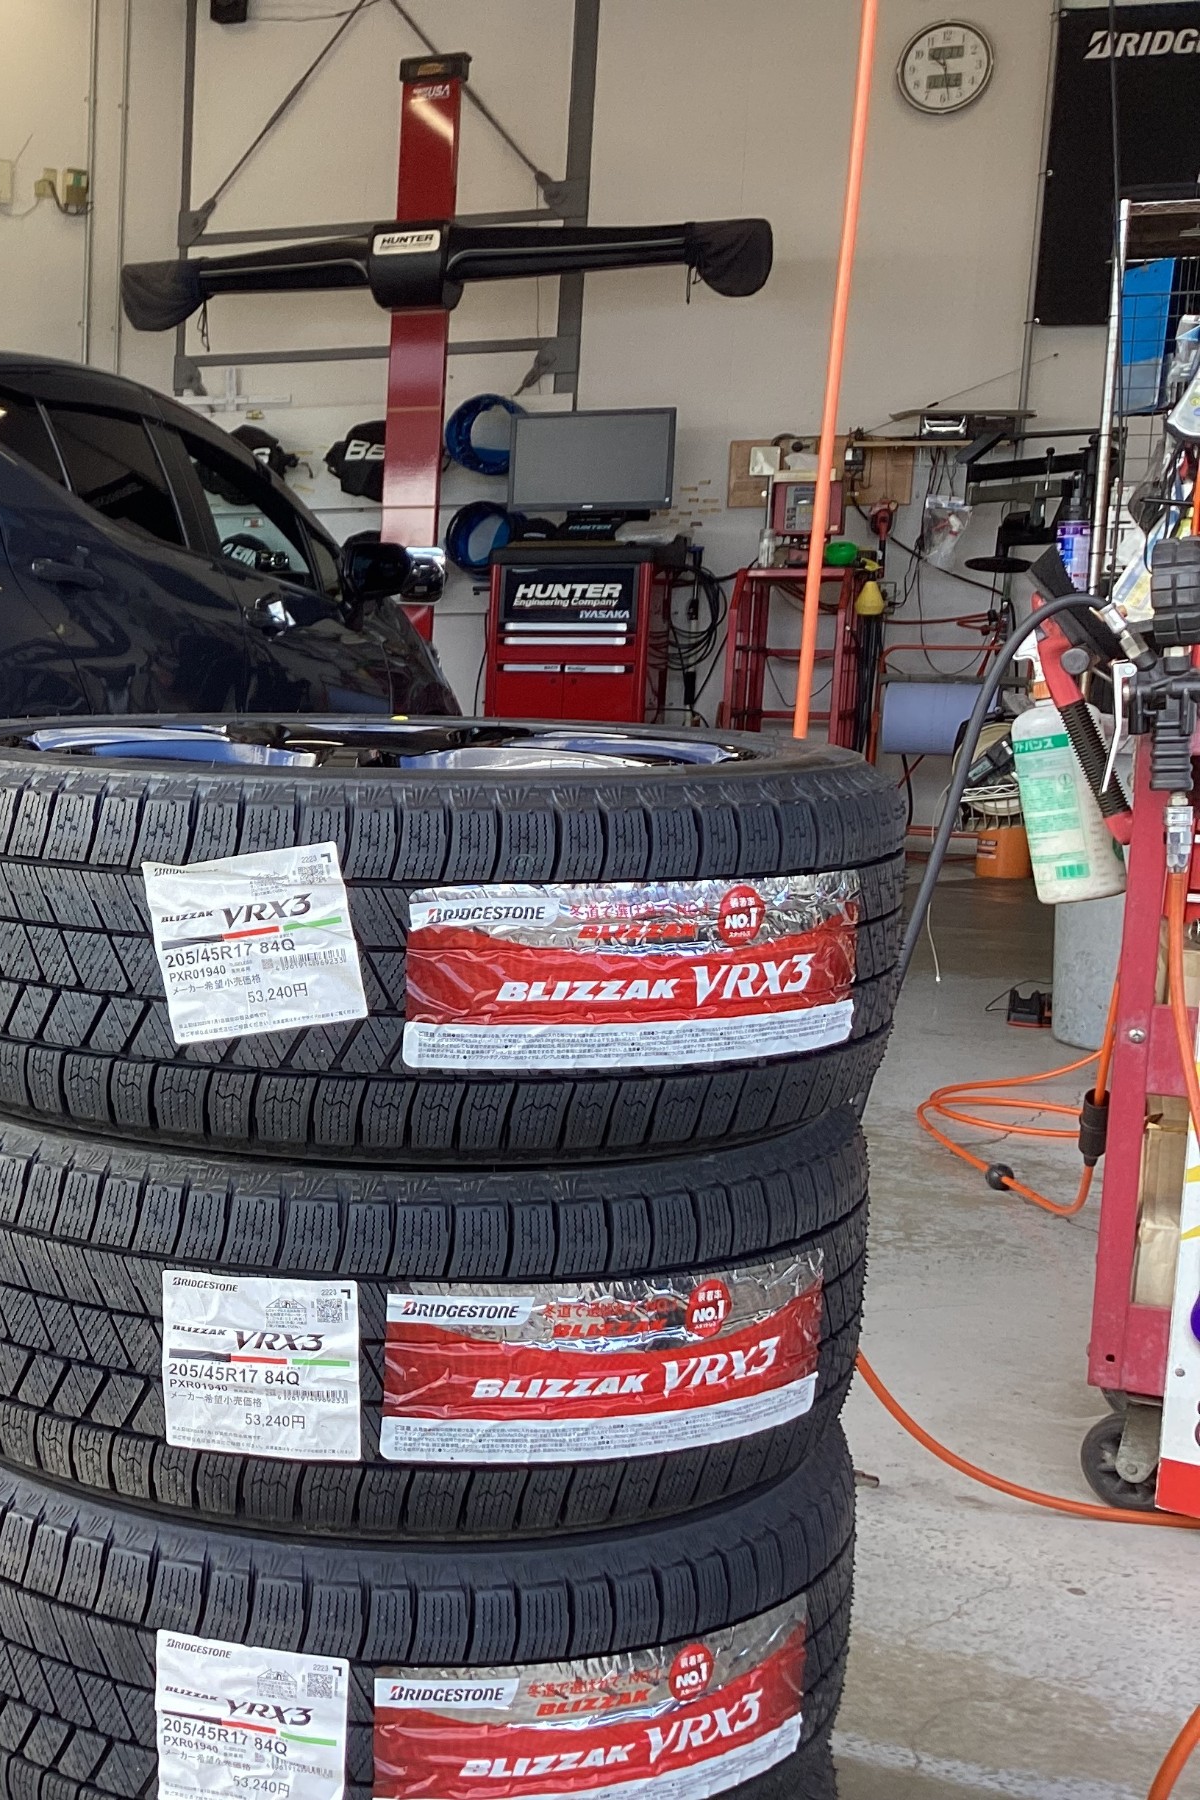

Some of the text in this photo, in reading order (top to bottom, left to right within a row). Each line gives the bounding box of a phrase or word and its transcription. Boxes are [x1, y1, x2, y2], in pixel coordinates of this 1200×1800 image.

[1083, 28, 1200, 59] BRIDG
[382, 234, 434, 244] HUNTER
[516, 584, 622, 598] HUNTER
[513, 598, 618, 608] Engineering Company
[580, 610, 630, 618] IYASAKA
[161, 893, 312, 929] BLIZZAK VRX3
[426, 906, 546, 923] BRIDGESTONE
[725, 908, 759, 929] NO.1
[165, 943, 252, 968] 205/45R17
[260, 939, 295, 954] 84Q
[169, 965, 226, 982] PXR01940
[495, 953, 816, 1007] BLIZZAK VRX3
[173, 974, 261, 995] メーカー希望小売価格
[248, 982, 308, 1003] 53,240円
[172, 1277, 238, 1292] BRIDGESTONE
[402, 1302, 520, 1318] BRIDGESTONE
[692, 1300, 726, 1323] NO.1
[172, 1325, 325, 1351] BLIZZAK VRX3
[170, 1363, 300, 1386] 205/45R17 84Q
[471, 1336, 782, 1399] BLIZZAK VRX3
[170, 1379, 228, 1392] PXR01940
[170, 1393, 262, 1407] メーカー希望小売価格
[245, 1413, 305, 1429] 53,240円
[166, 1638, 232, 1658] BRIDGESTONE
[675, 1662, 708, 1688] NO.1
[389, 1686, 504, 1701] BRIDGESTONE
[536, 1688, 651, 1716] BLIZZAK
[165, 1686, 314, 1725] BLIZZAK VRX3
[163, 1718, 248, 1745] 205/45R17
[255, 1735, 287, 1756] 84Q
[459, 1743, 637, 1777] BLIZZAK
[643, 1688, 765, 1764] VRX3
[163, 1735, 218, 1753] PXR01940
[233, 1776, 290, 1798] 53,240円
